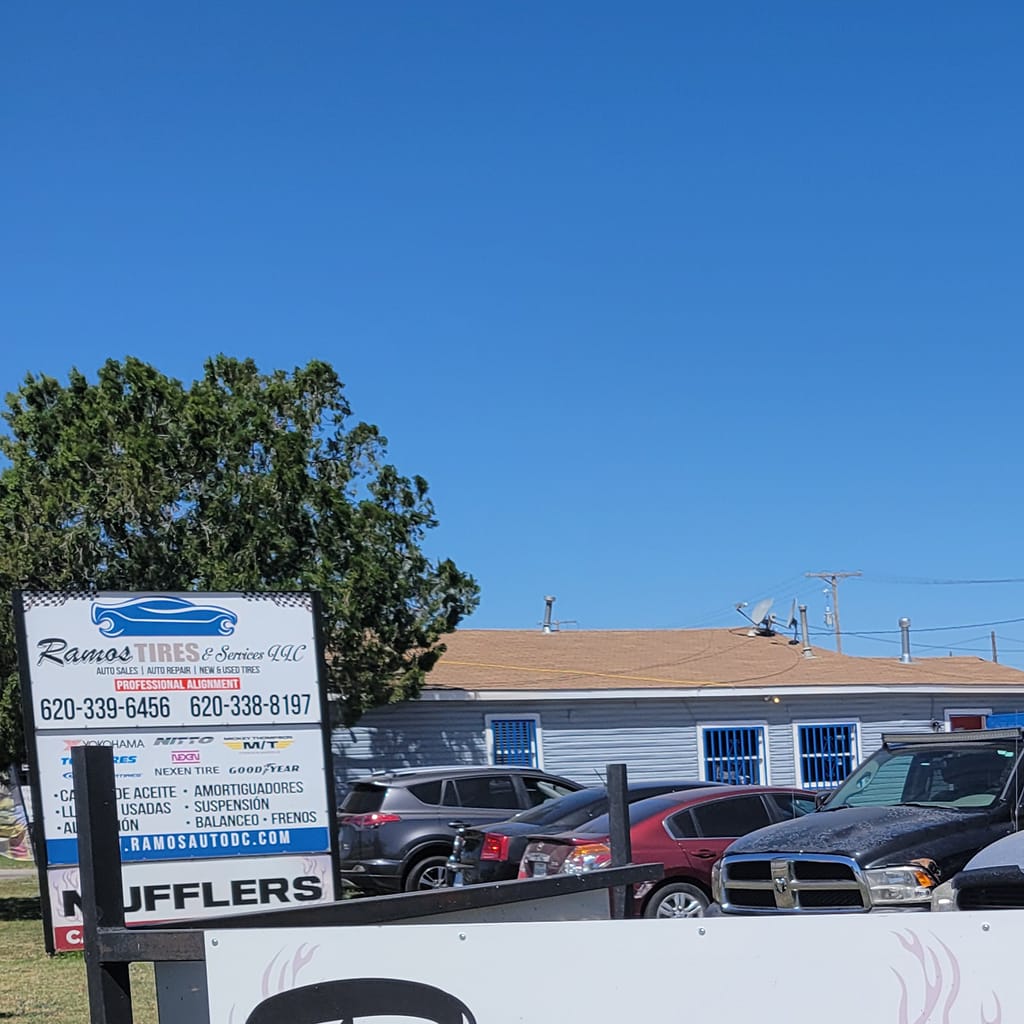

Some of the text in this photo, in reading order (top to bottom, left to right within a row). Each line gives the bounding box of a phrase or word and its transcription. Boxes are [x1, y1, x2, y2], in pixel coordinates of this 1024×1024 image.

[37, 638, 133, 667] Ramos
[134, 643, 200, 662] TIRES
[215, 645, 265, 662] Services
[96, 667, 115, 676] AUTO
[116, 666, 138, 675] SALES
[147, 666, 165, 675] AUTO
[166, 666, 191, 675] REPAIR
[199, 666, 215, 674] NEW
[223, 666, 240, 674] USED
[241, 665, 261, 674] TIRES
[116, 678, 239, 690] PROFESSIONAL ALIGNMENT
[40, 693, 311, 721] 620-339-6456 620-338-8197
[153, 736, 214, 746] NITTO
[243, 741, 279, 750] M/T
[154, 766, 220, 776] NEXEN TIRE
[229, 763, 300, 775] GOODYEAR
[133, 785, 177, 799] ACEITE
[194, 781, 304, 797] AMORTIGUADORES
[121, 801, 171, 816] USADAS
[194, 796, 270, 812] SUSPENSIÓN
[195, 811, 317, 828] BALANCEO FRENOS
[119, 831, 290, 853] .RAMOSAUTODC.COM
